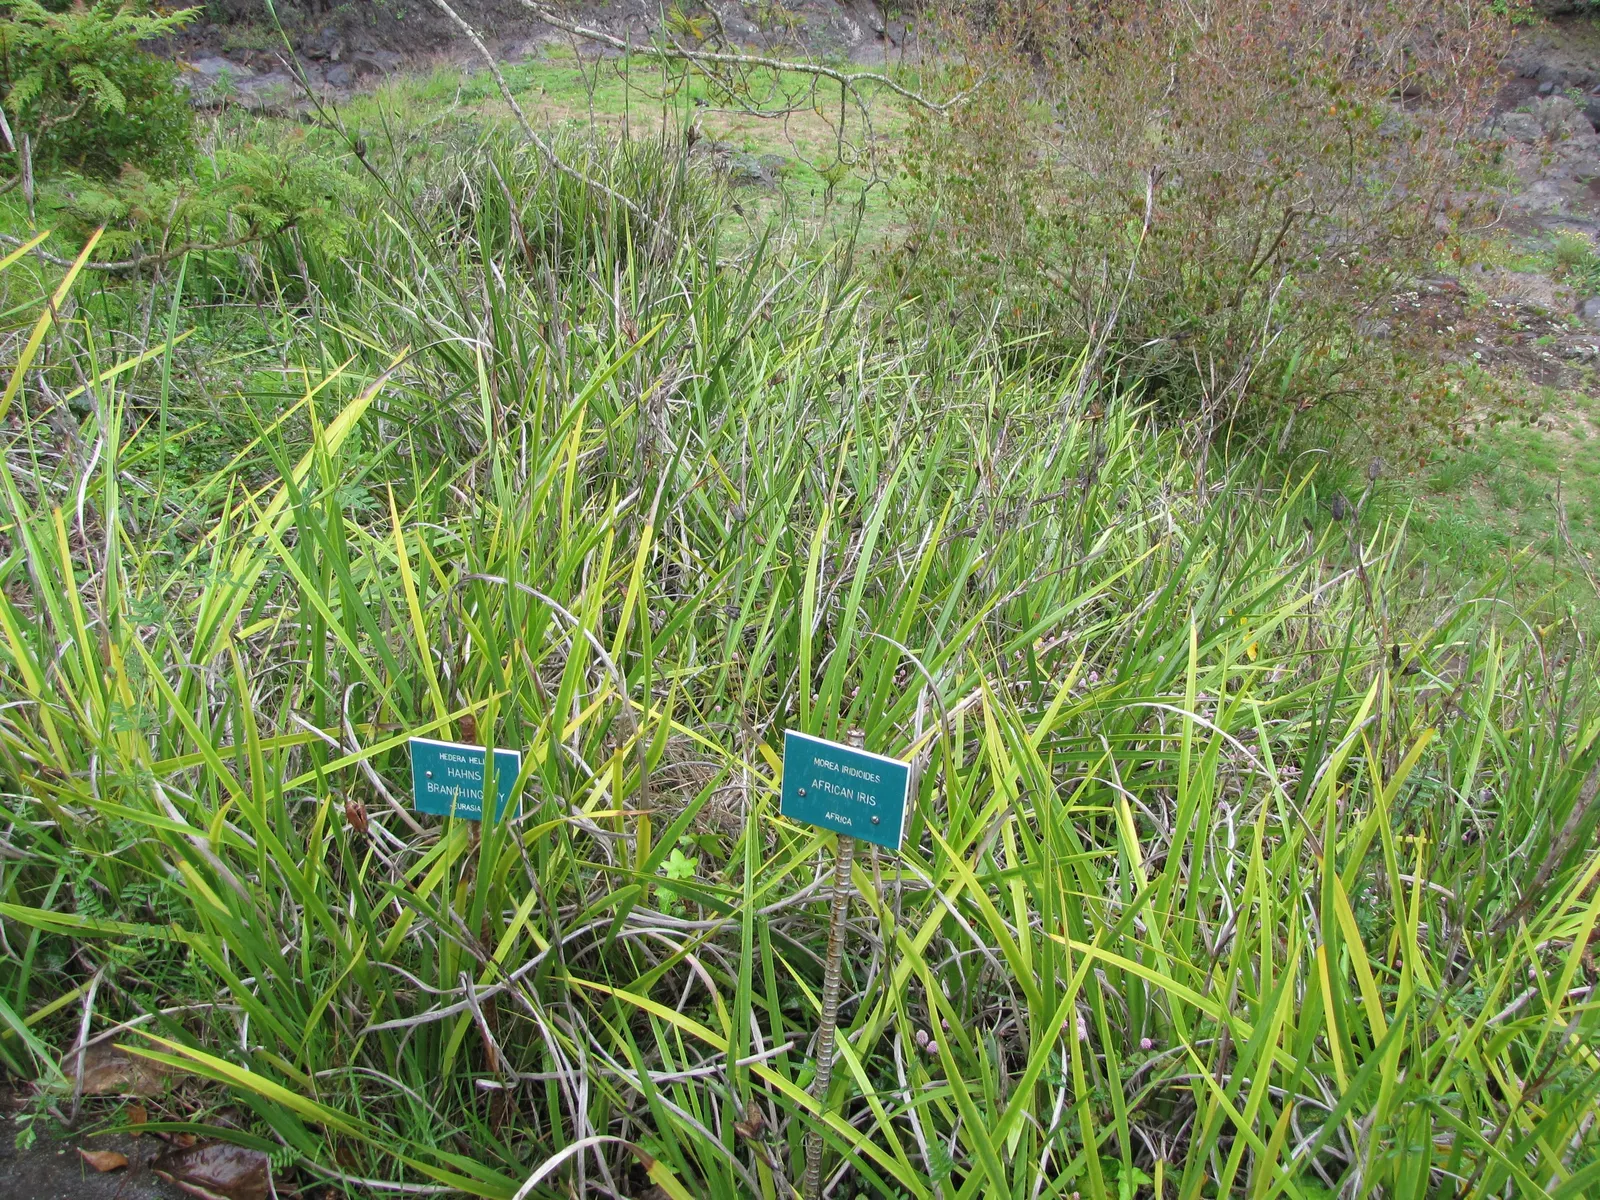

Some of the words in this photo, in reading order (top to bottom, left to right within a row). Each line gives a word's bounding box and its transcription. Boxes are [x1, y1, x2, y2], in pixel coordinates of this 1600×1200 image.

[439, 752, 466, 763] HEDERA
[813, 757, 839, 772] MOREA
[447, 767, 481, 781] HAHNS
[427, 782, 484, 799] BRANCHING
[811, 779, 854, 799] AFRICAN
[857, 792, 876, 806] IRIS
[825, 811, 852, 826] AFRICA
